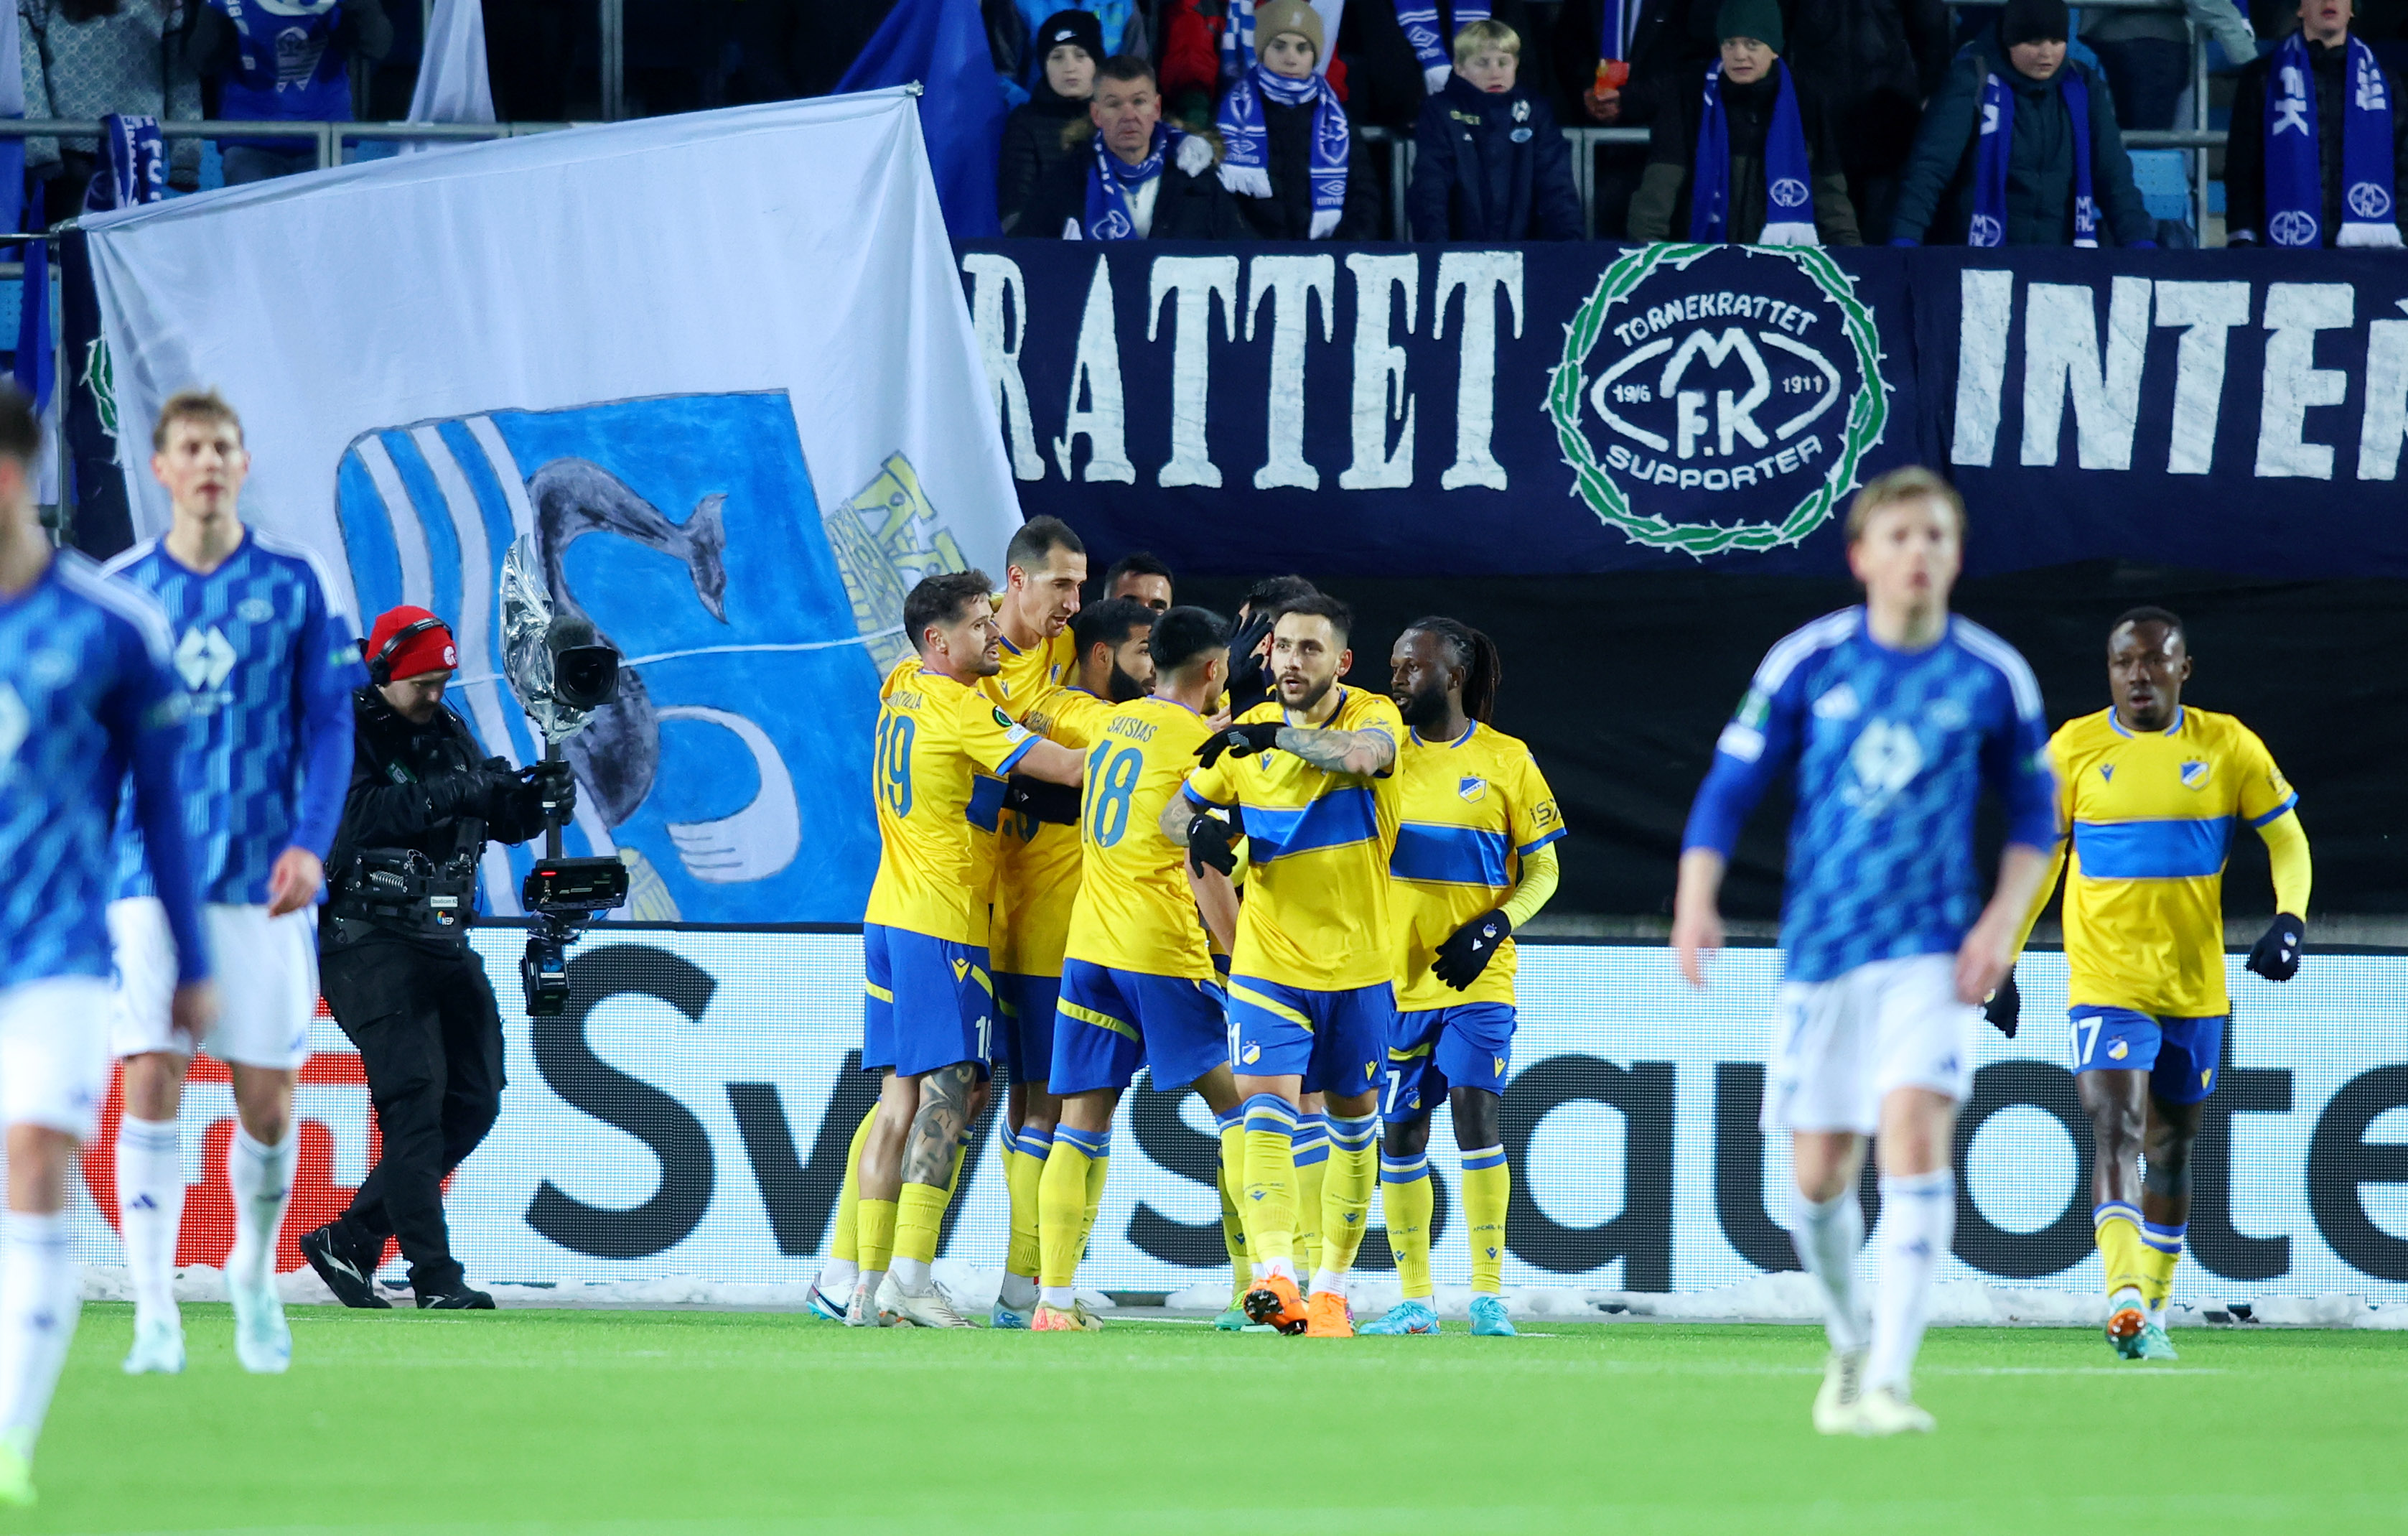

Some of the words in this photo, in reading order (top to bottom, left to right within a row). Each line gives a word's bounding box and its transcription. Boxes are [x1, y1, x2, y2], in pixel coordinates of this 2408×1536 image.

[1613, 292, 1818, 347] TORNEKRATTET
[1606, 434, 1822, 490] SUPPORTER
[1107, 715, 1158, 743] SATSIAS
[877, 709, 915, 819] 19
[1083, 739, 1143, 847] 18
[442, 916, 454, 926] NEP
[2069, 1015, 2104, 1069] 17
